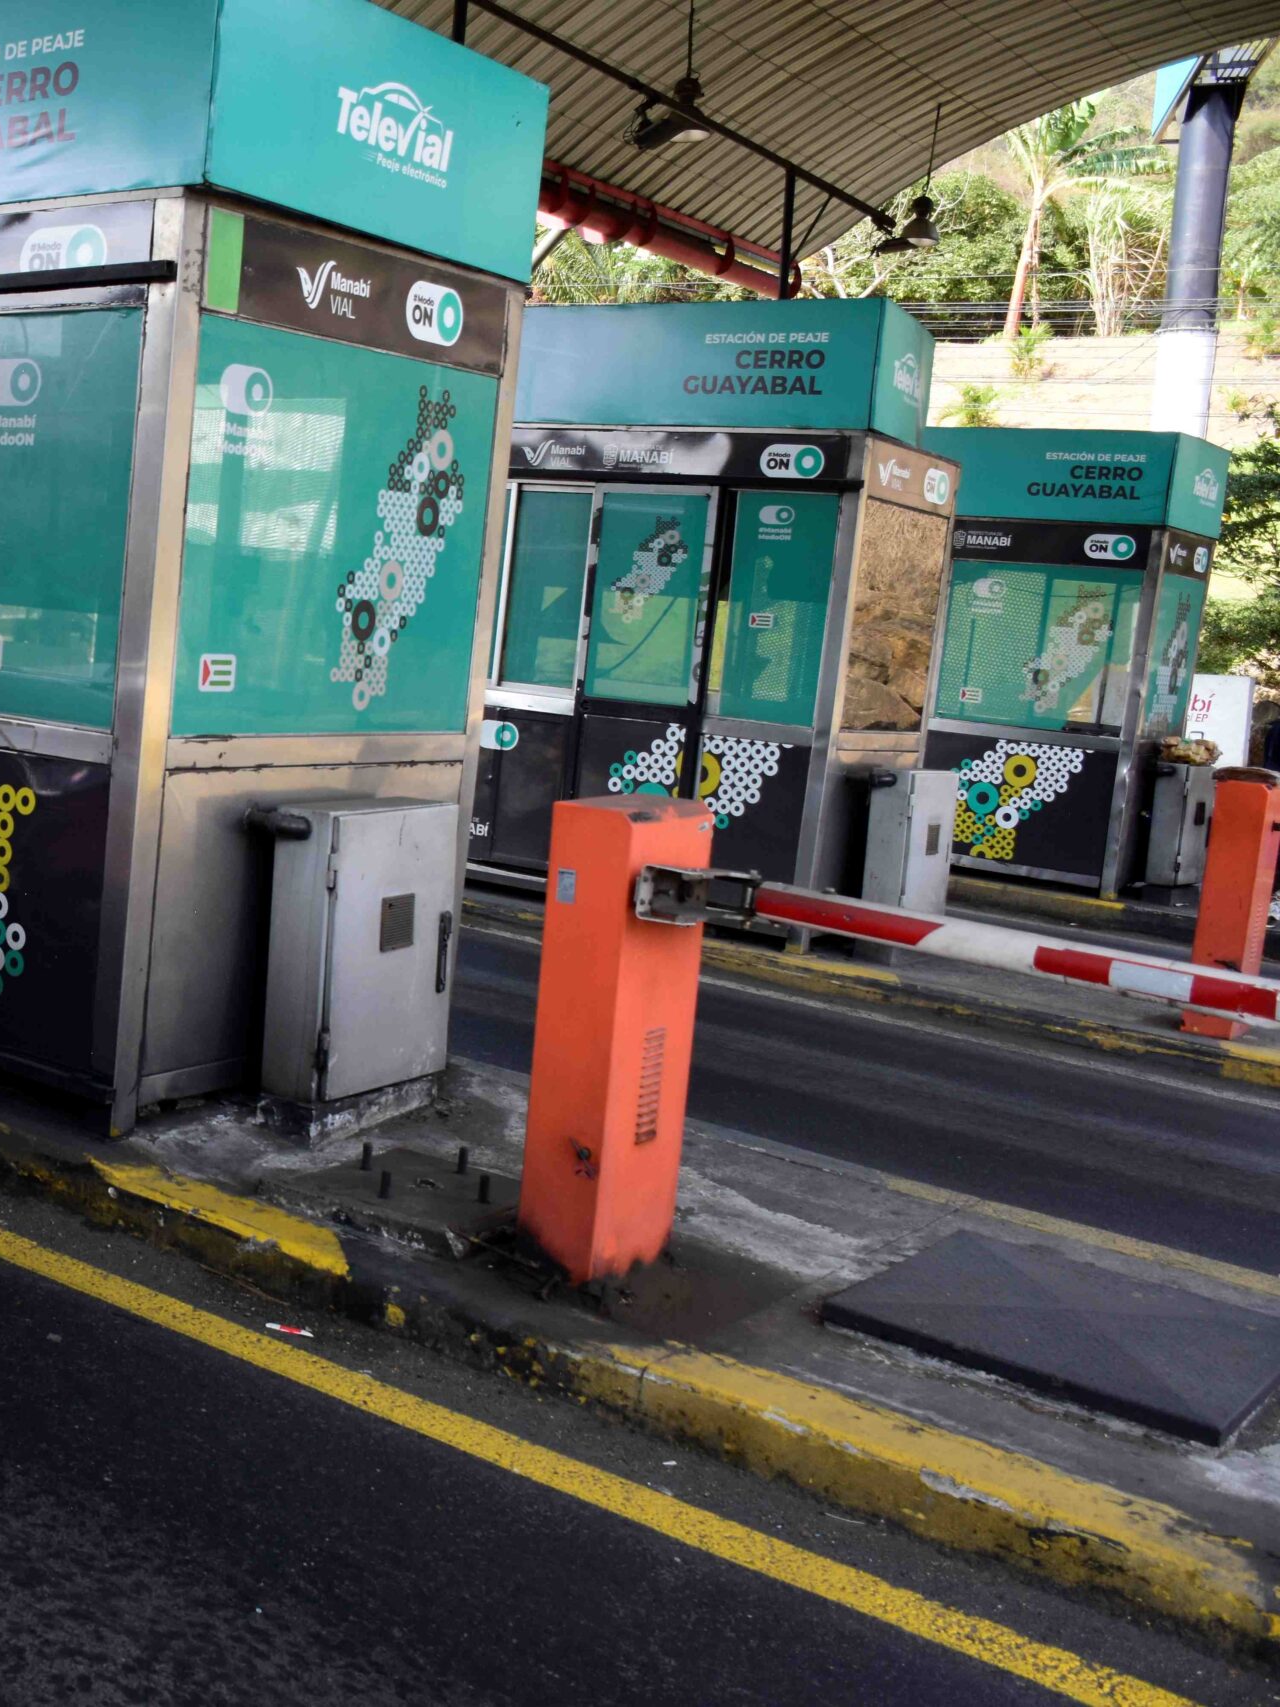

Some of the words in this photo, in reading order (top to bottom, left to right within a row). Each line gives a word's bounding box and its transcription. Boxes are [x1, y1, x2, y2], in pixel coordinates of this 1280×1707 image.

[4, 40, 28, 60] DE
[31, 29, 85, 56] PEAJE
[376, 152, 400, 173] Peaje
[402, 163, 448, 188] electrónico
[30, 241, 62, 252] #Modo
[29, 252, 61, 272] ON
[331, 271, 371, 298] Manabí
[330, 294, 356, 319] VIAL
[413, 294, 435, 307] #Modo
[412, 305, 433, 328] ON
[705, 331, 765, 344] ESTACIÓN
[769, 333, 786, 344] DE
[789, 332, 829, 344] PEAJE
[735, 349, 826, 370] CERRO
[683, 375, 823, 396] GUAYABAL
[551, 444, 587, 456] Manabí
[619, 448, 674, 465] MANABÍ
[1045, 451, 1094, 462] ESTACIÓN
[1097, 453, 1112, 463] DE
[1114, 453, 1147, 463] PEAJE
[551, 456, 573, 467] VIAL
[766, 457, 790, 470] ON
[1070, 464, 1143, 482] CERRO
[1027, 481, 1140, 501] GUAYABAL
[966, 534, 1012, 547] MANABÍ
[1089, 543, 1108, 553] ON
[1190, 693, 1216, 713] bí
[1195, 713, 1209, 722] EP
[469, 821, 490, 837] ABÍ
